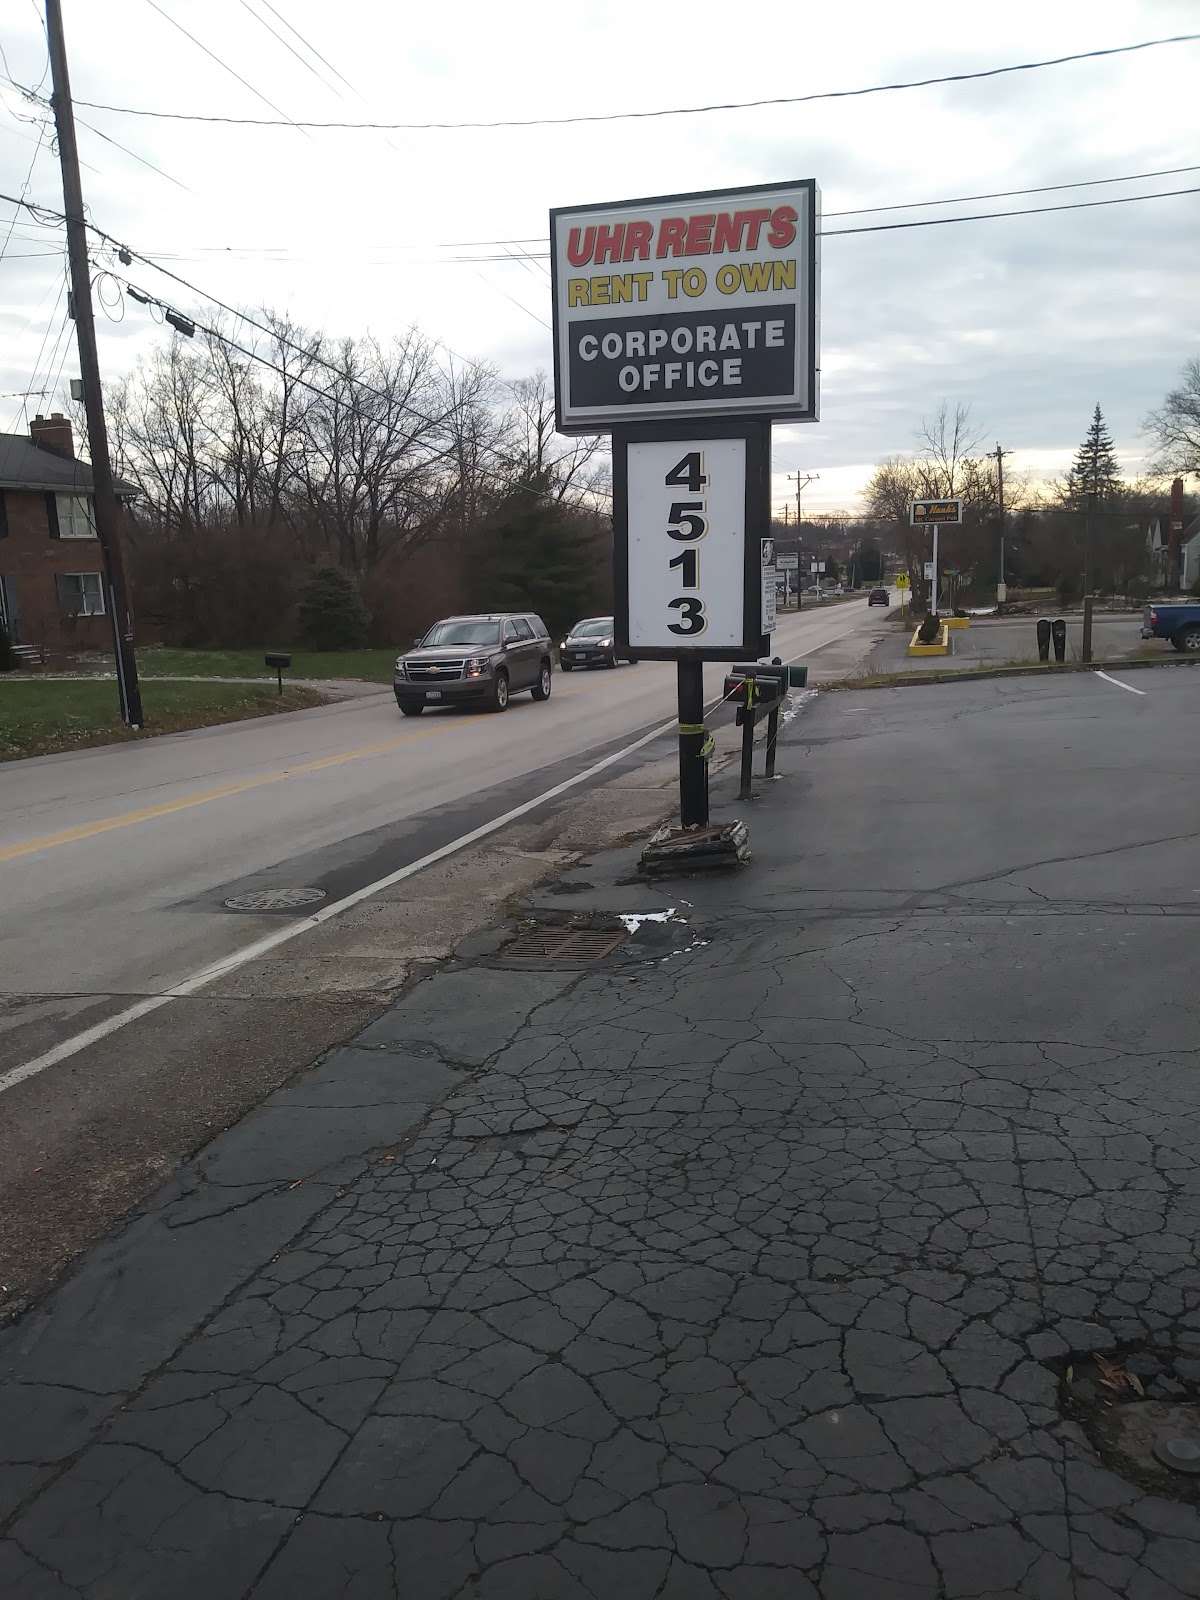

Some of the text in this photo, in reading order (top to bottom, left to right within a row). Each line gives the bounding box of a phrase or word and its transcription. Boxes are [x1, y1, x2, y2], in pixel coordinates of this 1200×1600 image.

[567, 205, 798, 267] UHR RENTS
[568, 260, 796, 307] RENT TO OWN
[578, 320, 785, 362] CORPORATE
[618, 358, 742, 392] OFFICE
